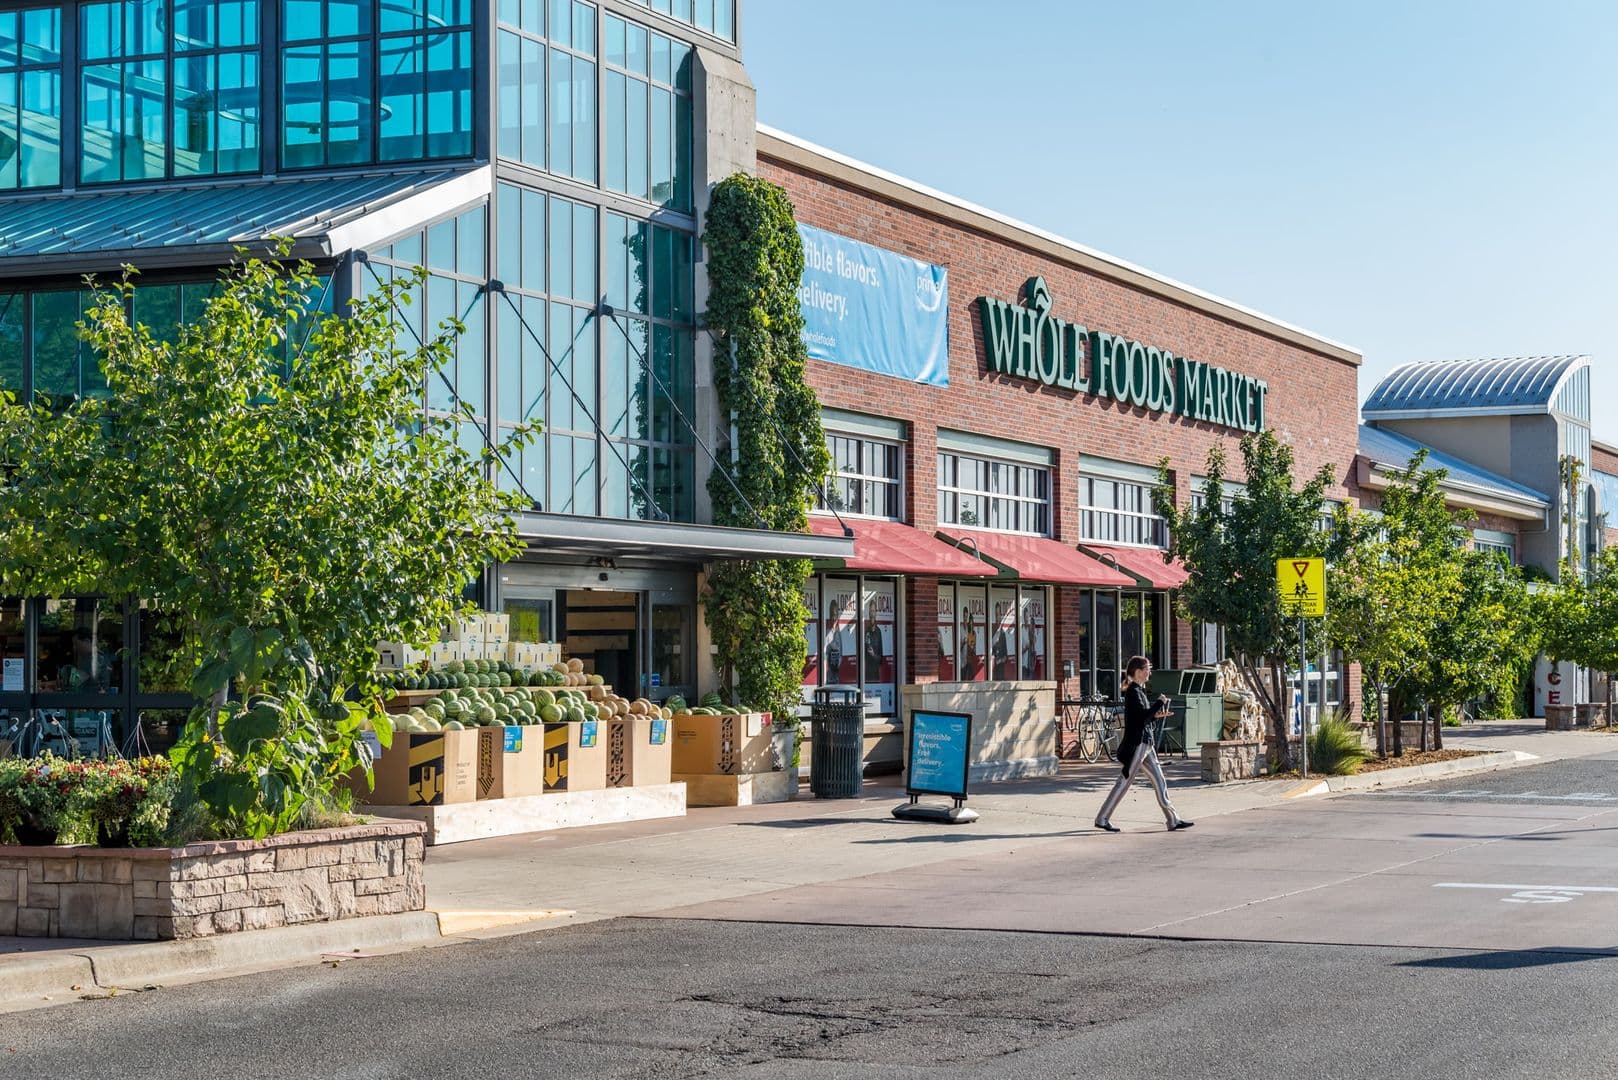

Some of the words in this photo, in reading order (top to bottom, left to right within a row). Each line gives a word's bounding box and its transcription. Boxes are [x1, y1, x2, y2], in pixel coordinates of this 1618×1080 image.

[804, 242, 833, 273] tible
[836, 249, 880, 288] flavors.
[981, 278, 1089, 392] WHOLE
[1094, 332, 1175, 414] FOODS
[1178, 359, 1268, 433] MARKET
[804, 592, 817, 611] CAL
[874, 595, 894, 613] LOCAL
[938, 598, 953, 615] OCAL
[968, 599, 985, 616] LOCAL
